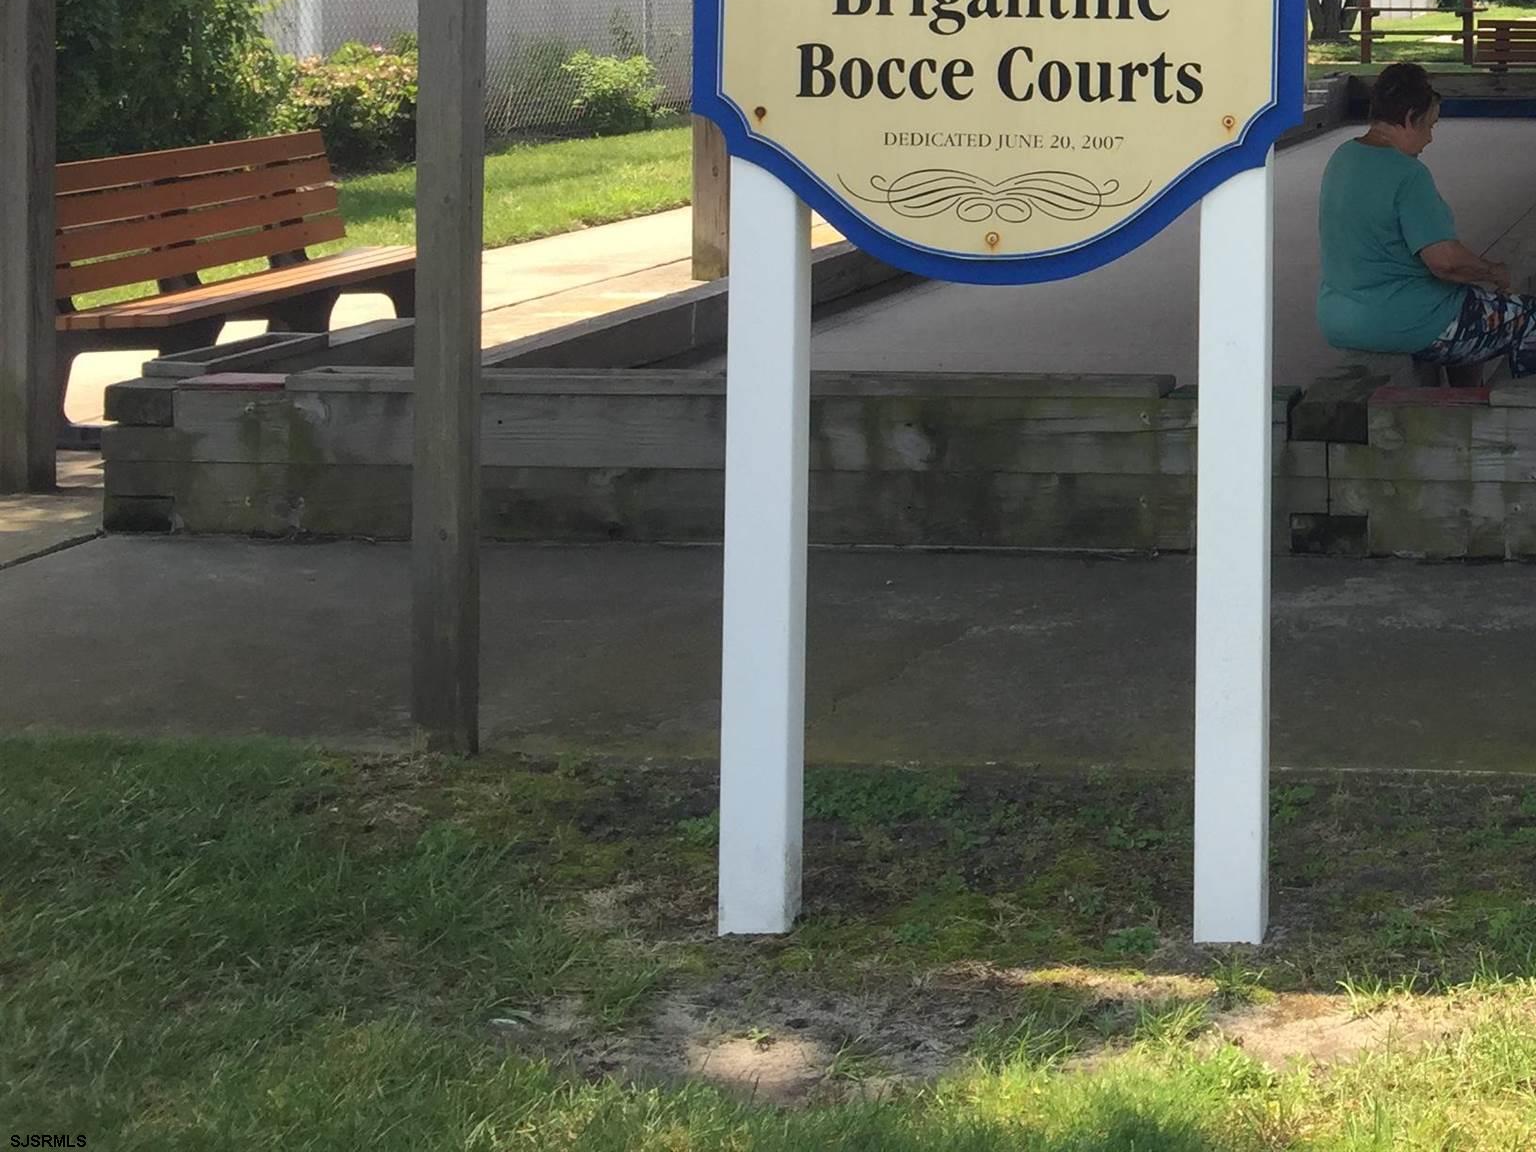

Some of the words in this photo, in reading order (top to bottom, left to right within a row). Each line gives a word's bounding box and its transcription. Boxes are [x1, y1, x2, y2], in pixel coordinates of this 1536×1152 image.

[796, 43, 974, 101] Bocce
[998, 46, 1205, 104] Courts
[883, 132, 992, 148] DEDICATED
[995, 134, 1044, 151] JUNE
[1049, 135, 1075, 150] 20,
[1081, 135, 1124, 150] 2007
